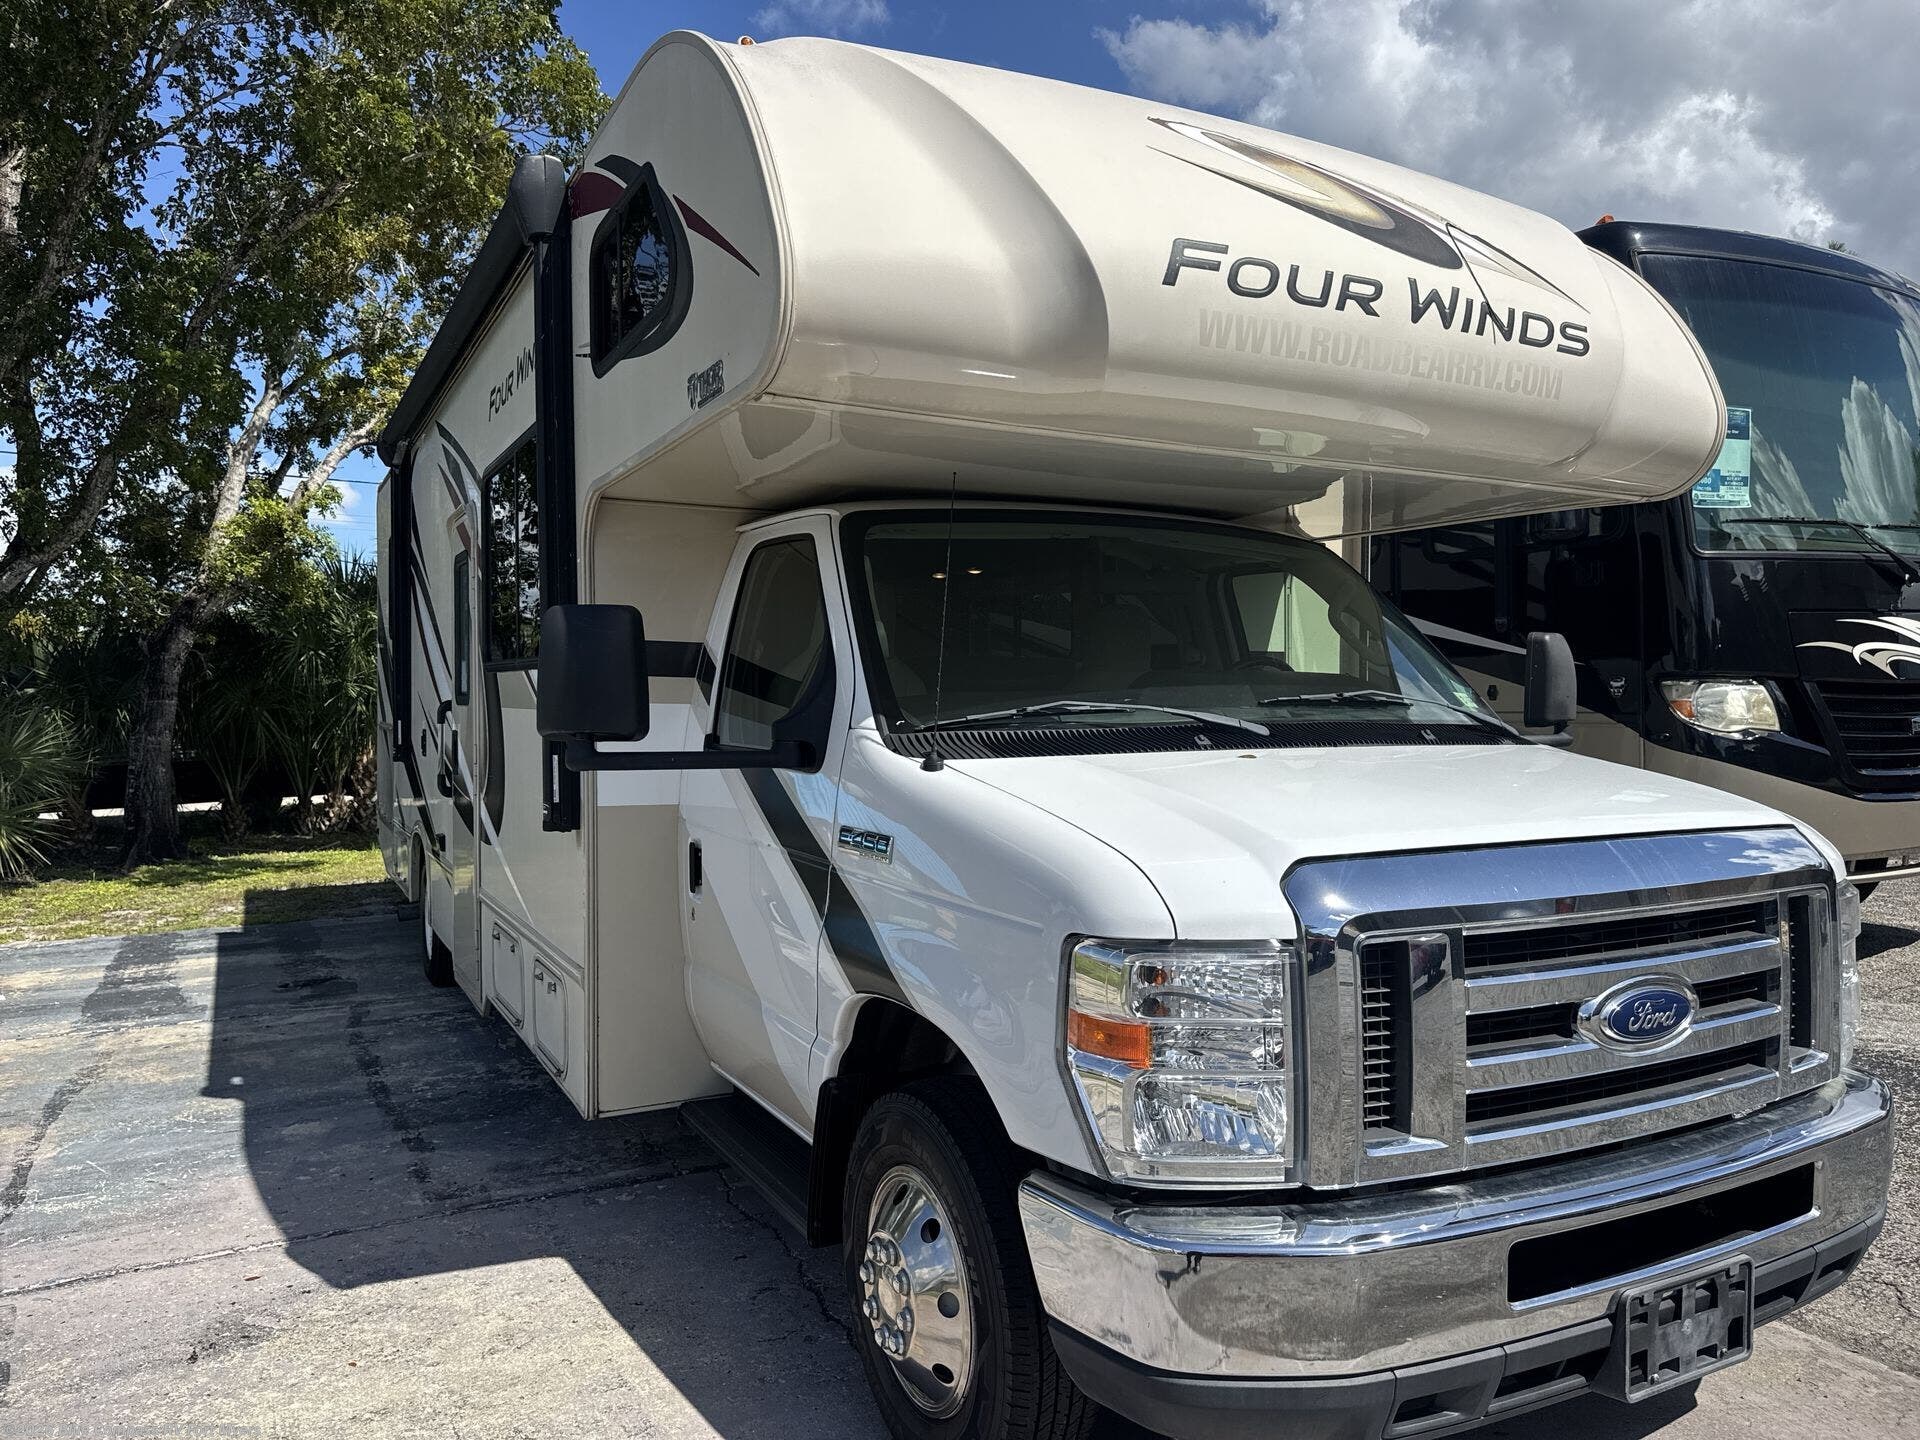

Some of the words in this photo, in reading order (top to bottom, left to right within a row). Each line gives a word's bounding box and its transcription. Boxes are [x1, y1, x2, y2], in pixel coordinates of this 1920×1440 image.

[1162, 237, 1383, 317] FOUR
[1408, 276, 1590, 357] WINDS
[488, 369, 514, 422] FOUR
[516, 342, 536, 390] WIN
[1199, 308, 1563, 400] WWW.ROADBEARRV.COM
[1628, 999, 1677, 1032] Ford
